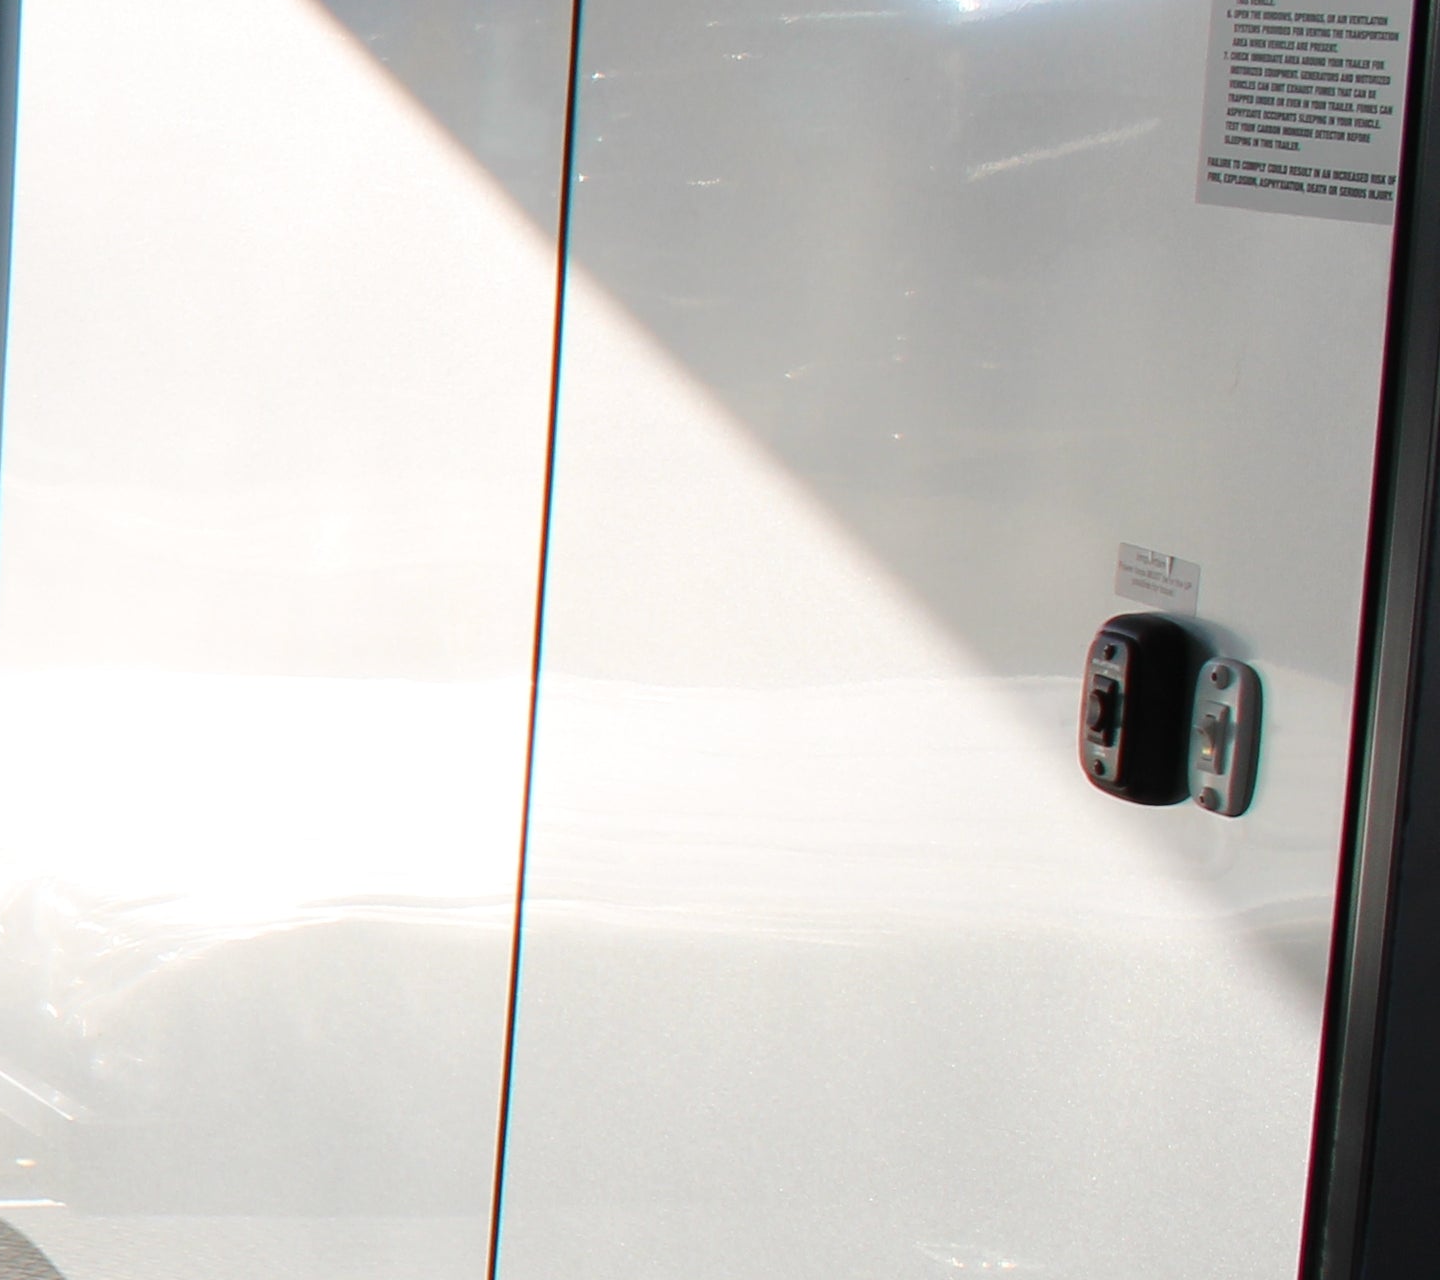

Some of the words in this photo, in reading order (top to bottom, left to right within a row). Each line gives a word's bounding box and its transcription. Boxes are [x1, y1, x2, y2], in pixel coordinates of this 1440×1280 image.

[1234, 10, 1249, 20] OPEN
[1251, 11, 1261, 20] THE
[1327, 14, 1336, 23] OR
[1337, 15, 1348, 24] AIR
[1349, 15, 1389, 26] VENTILATION
[1293, 27, 1304, 36] FOR
[1333, 29, 1344, 38] THE
[1233, 38, 1248, 48] AREA
[1249, 39, 1267, 49] WHEN
[1268, 40, 1295, 50] VEHICLES
[1296, 41, 1308, 51] ARE
[1230, 52, 1249, 62] CHECK
[1285, 55, 1300, 65] AREA
[1328, 58, 1344, 68] YOUR
[1345, 59, 1370, 69] TRAILER
[1372, 61, 1386, 70] FOR
[1341, 73, 1354, 83] AND
[1229, 80, 1256, 91] VEHICLES
[1257, 82, 1270, 92] CAN
[1286, 84, 1313, 95] EXHAUST
[1337, 87, 1352, 97] THAT
[1353, 88, 1367, 98] CAN
[1368, 89, 1377, 99] BE
[1228, 94, 1254, 105] TRAPPED
[1276, 98, 1285, 107] OR
[1286, 98, 1302, 108] EVEN
[1303, 99, 1310, 109] IN
[1311, 100, 1327, 110] YOUR
[1379, 105, 1394, 115] CAN
[1299, 114, 1327, 125] SLEEPING
[1329, 116, 1335, 125] IN
[1337, 117, 1353, 127] YOUR
[1226, 122, 1239, 132] TEST
[1240, 123, 1256, 133] YOUR
[1347, 132, 1372, 143] BEFORE
[1225, 135, 1251, 147] SLEEPING
[1253, 138, 1259, 147] IN
[1261, 139, 1273, 149] THIS
[1208, 158, 1232, 169] FAILURE
[1233, 160, 1241, 170] TO
[1242, 161, 1266, 173] COMPLY
[1267, 163, 1288, 175] COULD
[1289, 166, 1312, 177] RESULT
[1313, 168, 1321, 178] IN
[1322, 169, 1331, 179] AN
[1333, 170, 1369, 183] INCREASED
[1370, 174, 1386, 185] RISK
[1387, 175, 1397, 186] OF
[1306, 183, 1327, 194] DEATH
[1328, 185, 1338, 195] OR
[1339, 186, 1367, 198] SERIOUS
